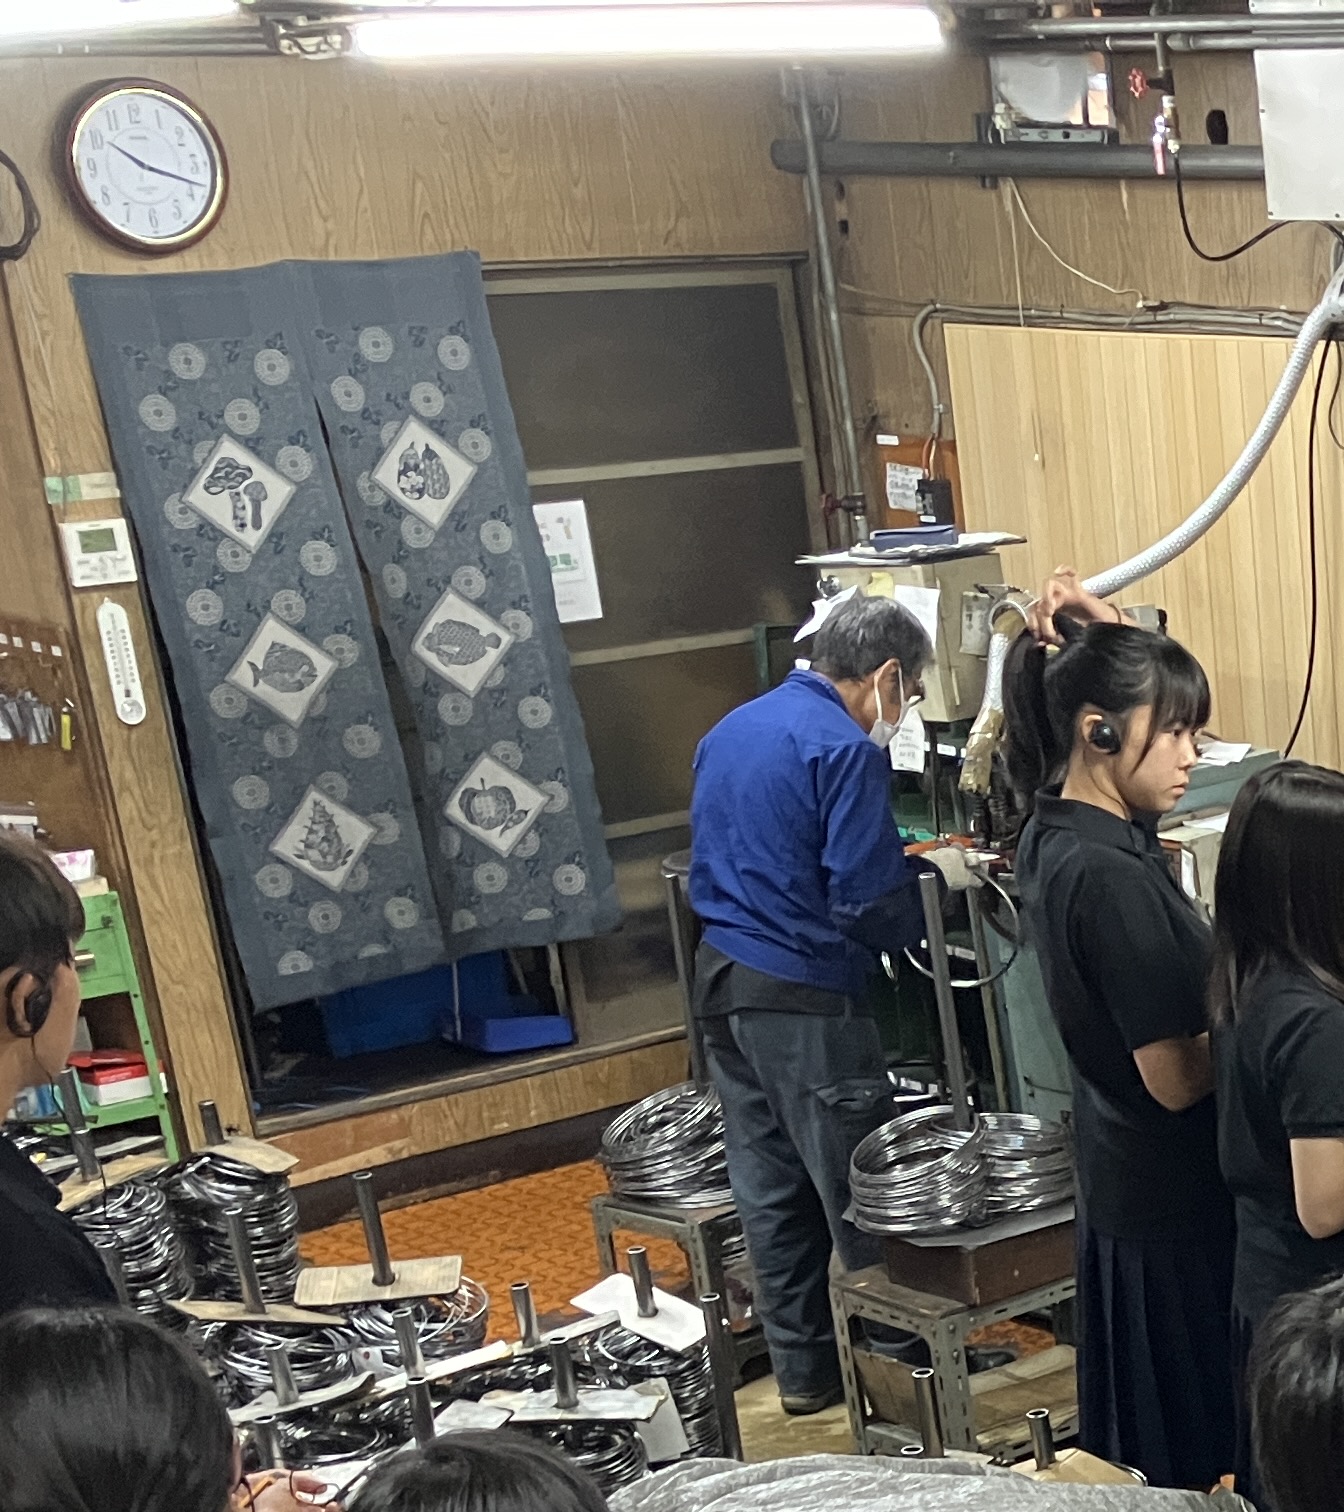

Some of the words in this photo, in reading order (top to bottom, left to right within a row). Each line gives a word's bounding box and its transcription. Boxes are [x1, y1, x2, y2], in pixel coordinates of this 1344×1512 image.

[106, 109, 120, 131] 11
[127, 103, 141, 124] 12
[155, 109, 163, 130] 1
[89, 128, 104, 150] 10
[175, 126, 186, 147] 2
[87, 157, 98, 179] 9
[100, 185, 111, 206] 8
[123, 202, 130, 223] 7
[149, 208, 159, 229] 6
